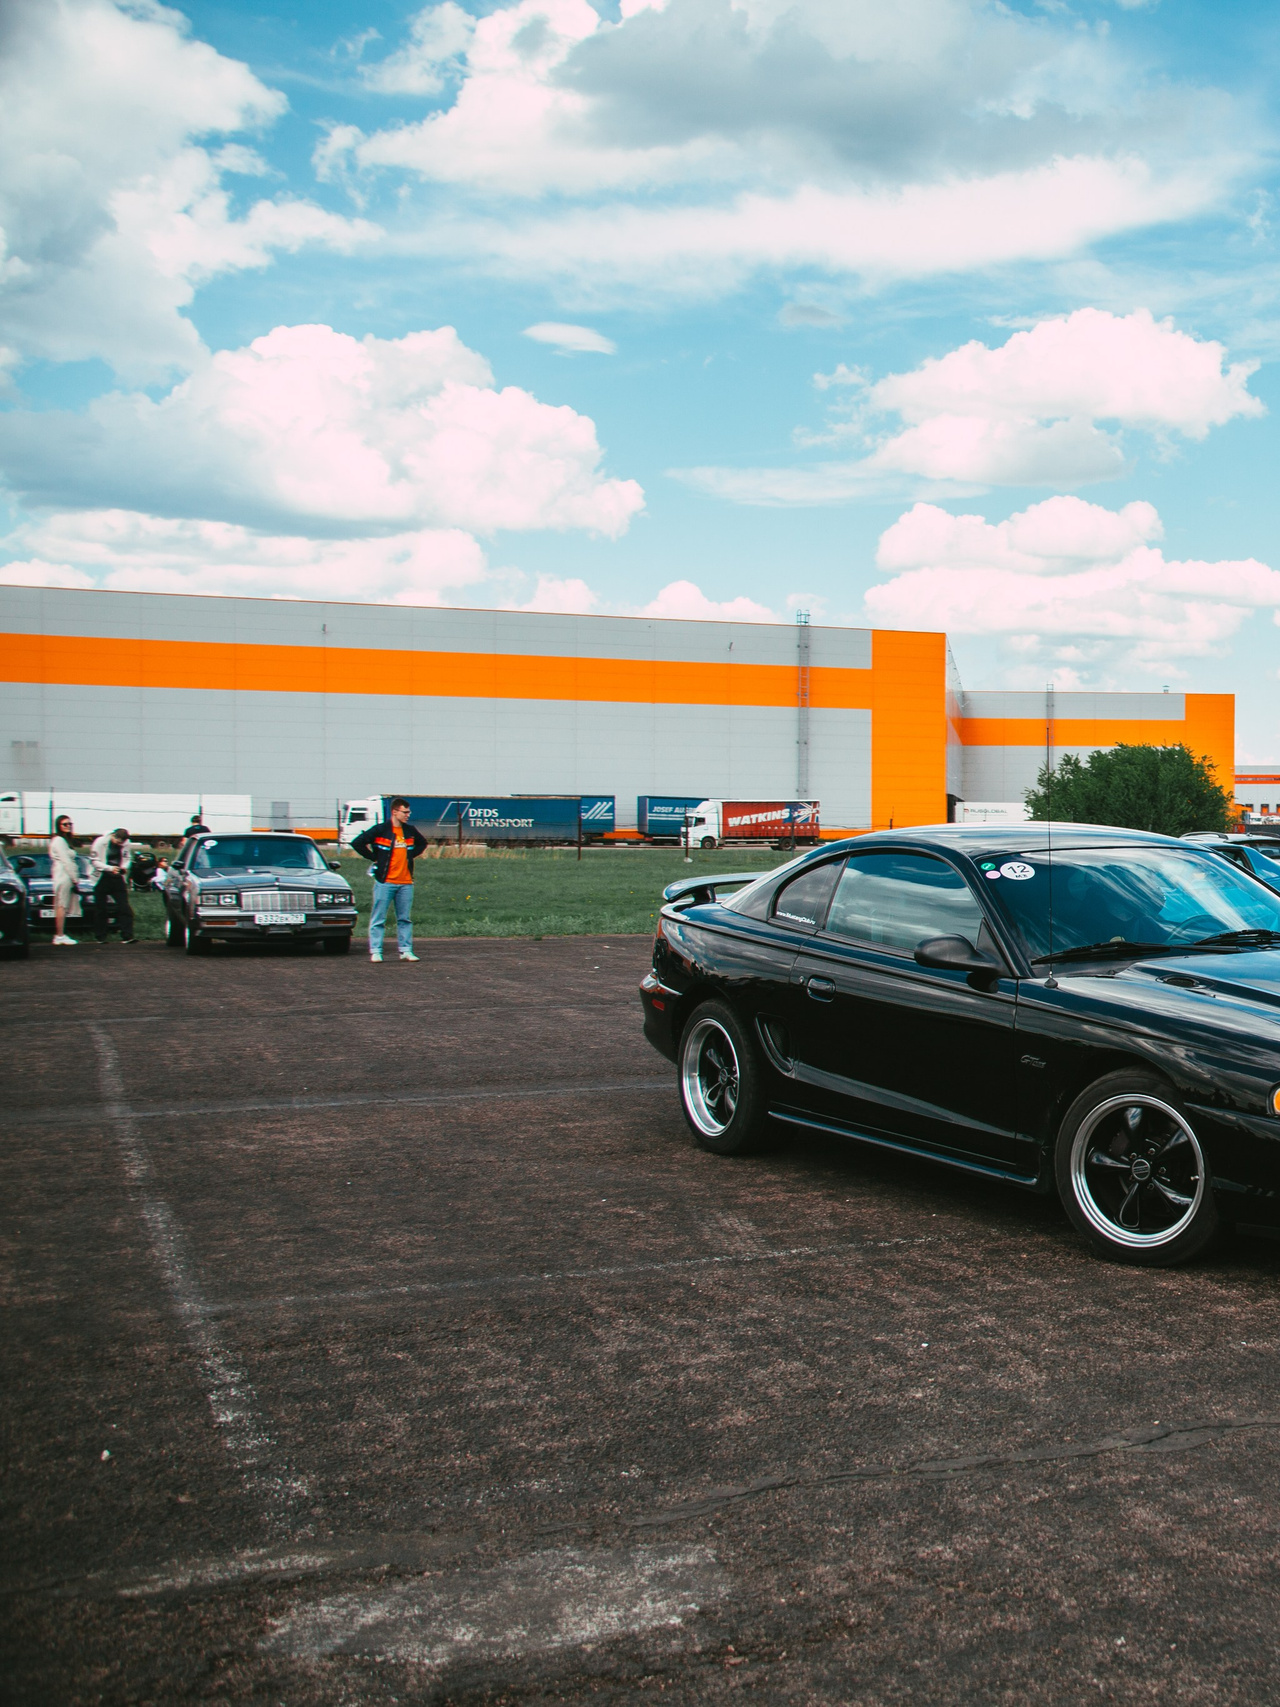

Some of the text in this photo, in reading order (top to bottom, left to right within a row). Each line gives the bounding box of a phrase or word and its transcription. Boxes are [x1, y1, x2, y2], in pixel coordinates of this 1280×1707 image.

[469, 808, 499, 818] DFDS
[728, 808, 790, 828] WATKINS
[469, 818, 534, 828] TRANSPORT
[1007, 865, 1030, 874] 12
